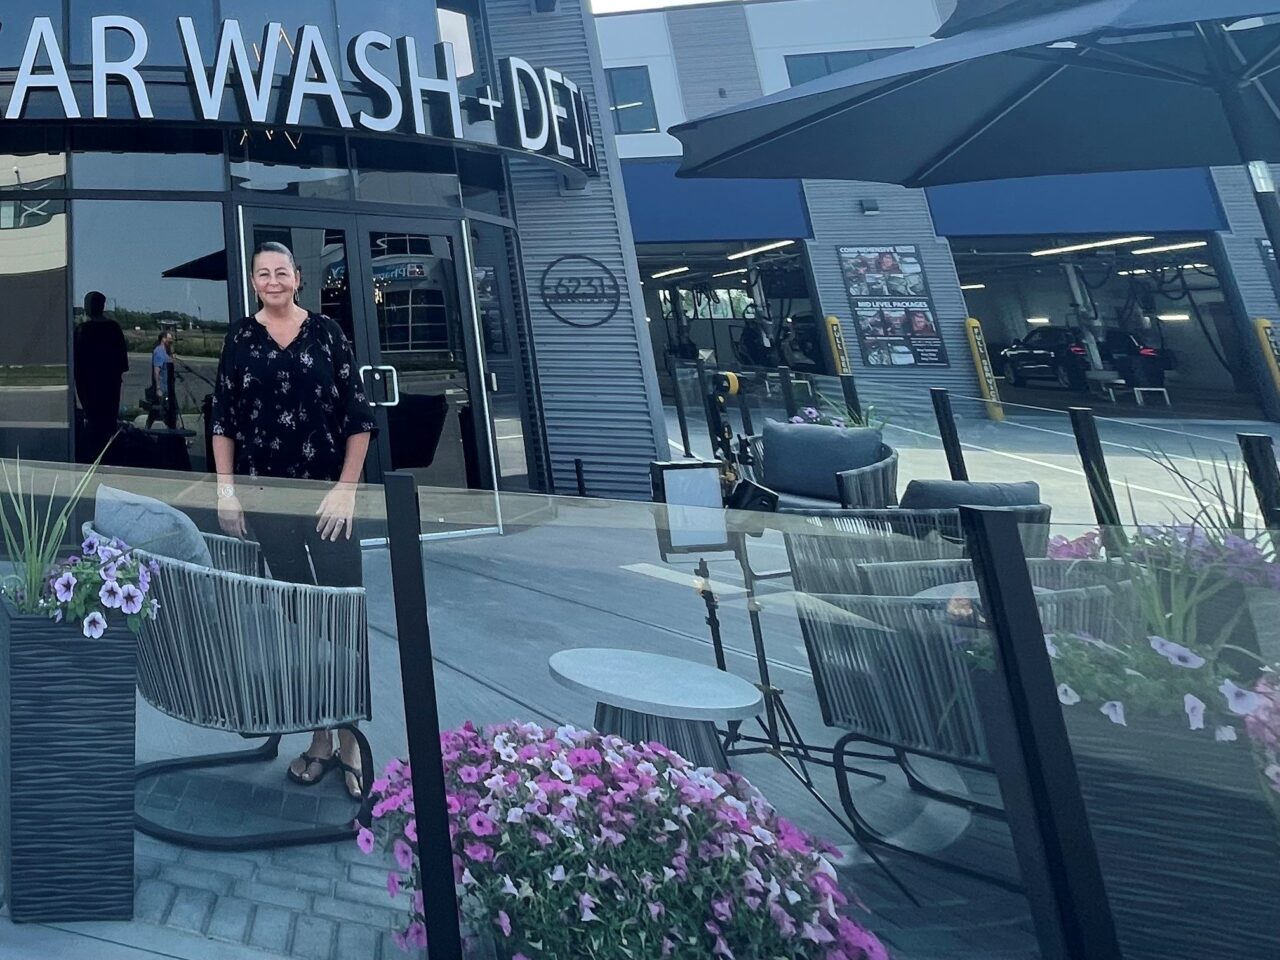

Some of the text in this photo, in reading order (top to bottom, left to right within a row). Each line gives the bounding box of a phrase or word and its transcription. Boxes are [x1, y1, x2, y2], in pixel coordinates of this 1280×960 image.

[178, 16, 463, 139] WASH
[555, 277, 605, 295] 6231
[832, 325, 842, 350] FULL
[974, 327, 985, 353] FULL
